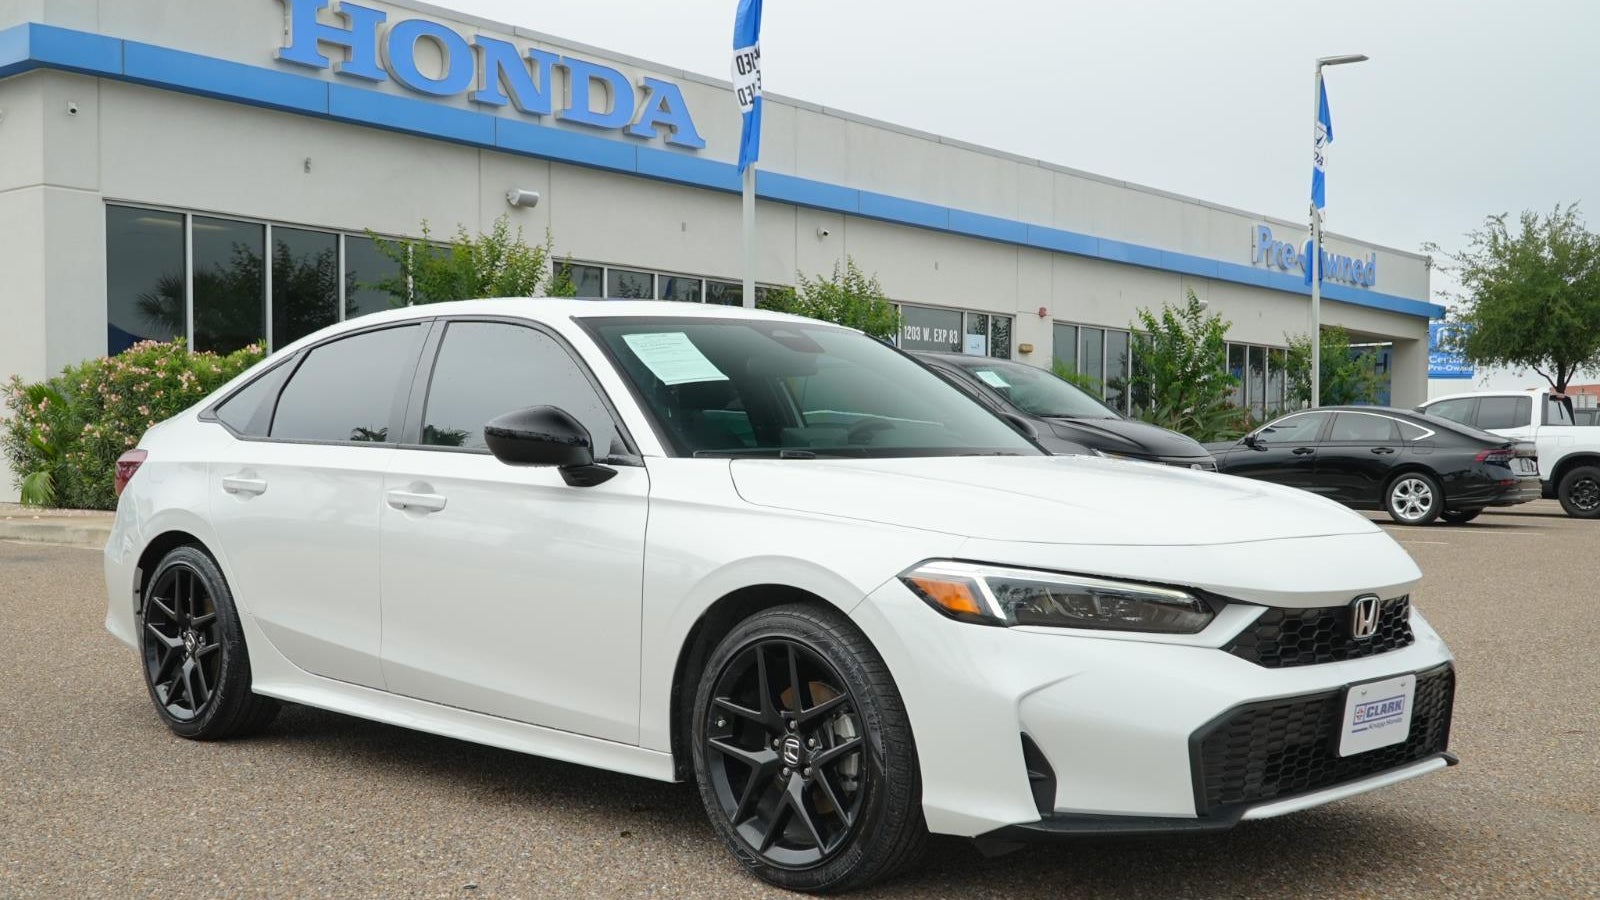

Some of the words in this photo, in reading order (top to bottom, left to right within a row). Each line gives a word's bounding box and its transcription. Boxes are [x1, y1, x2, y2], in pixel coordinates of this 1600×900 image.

[274, 0, 706, 149] HONDA
[1252, 224, 1376, 286] Pre-wned
[904, 326, 920, 341] 1203
[923, 327, 931, 342] W.
[934, 328, 947, 343] EXP
[949, 329, 958, 344] 83
[1366, 700, 1402, 718] CLARK
